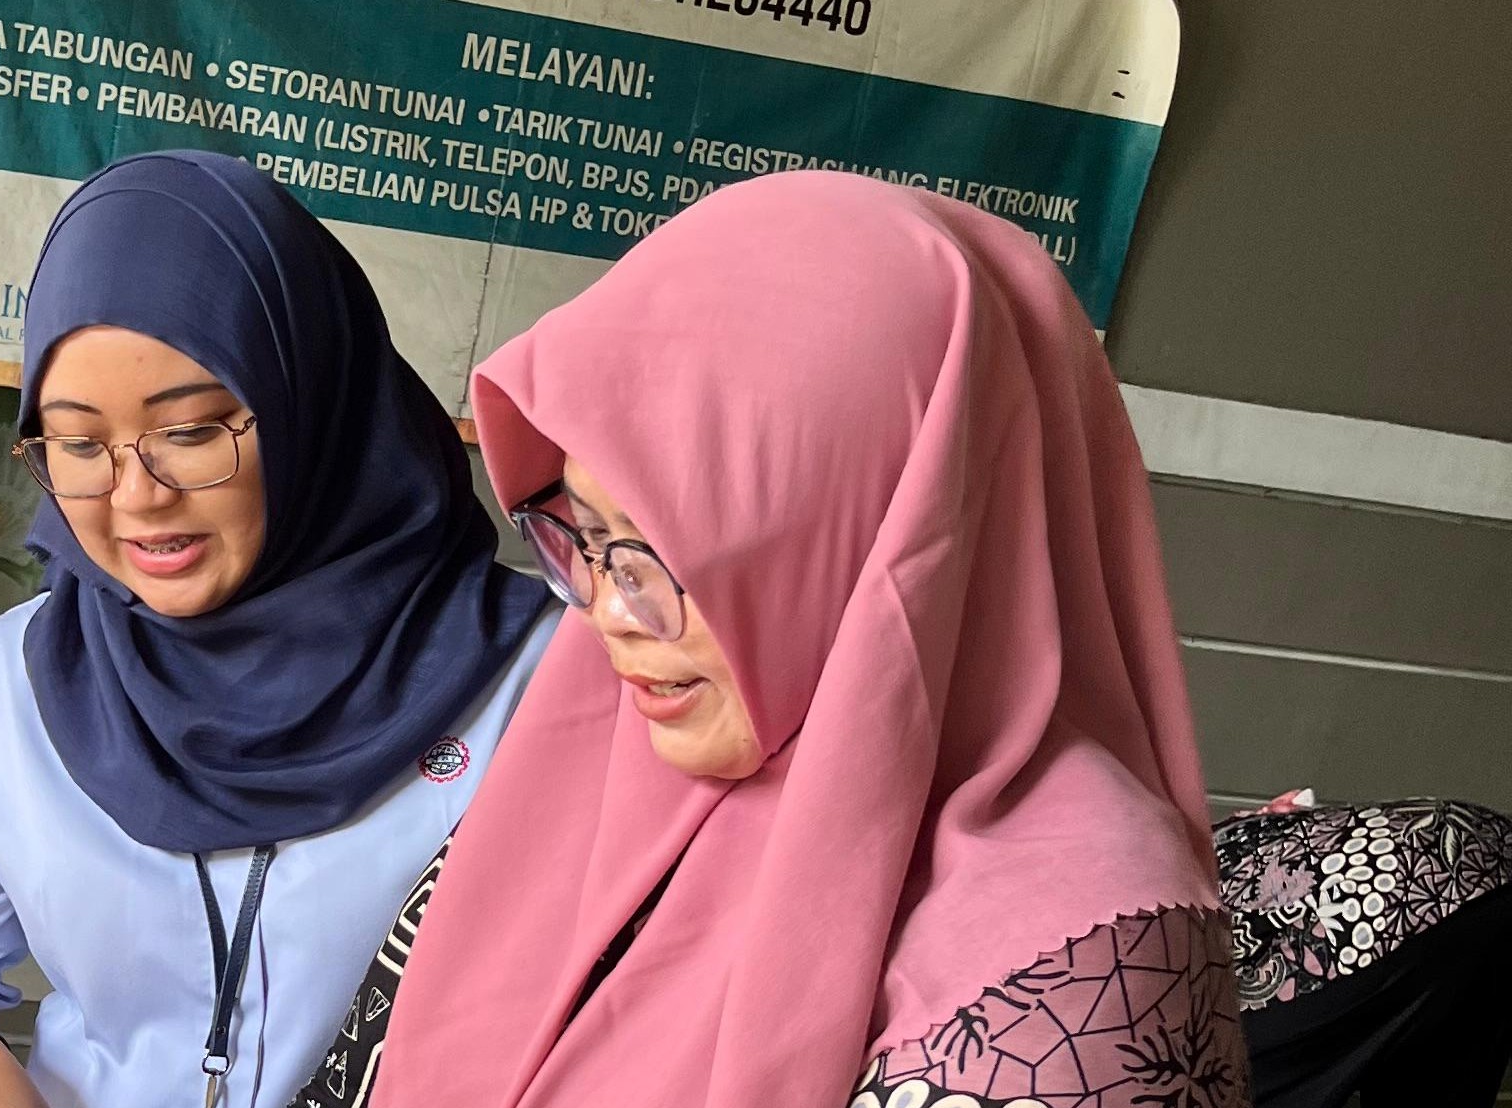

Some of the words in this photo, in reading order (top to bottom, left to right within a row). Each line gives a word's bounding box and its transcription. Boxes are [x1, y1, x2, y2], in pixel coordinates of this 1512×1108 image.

[461, 32, 655, 99] MELAYANI:
[14, 22, 194, 80] TABUNGAN
[225, 60, 372, 110] SETORAN
[375, 84, 466, 126] TUNAI
[493, 104, 574, 144] TARIK
[577, 118, 664, 158] TUNAI
[936, 177, 1079, 224] ELEKTRONIK
[96, 82, 308, 143] PEMBAYARAN
[314, 117, 438, 168] (LISTRIK,
[441, 139, 574, 190] TELEPON,
[581, 162, 655, 202] BPJS,
[662, 174, 728, 203] PDA
[256, 152, 426, 204] PEMBELIAN
[430, 180, 522, 220] PULSA
[529, 195, 568, 224] HP
[571, 202, 594, 231] &
